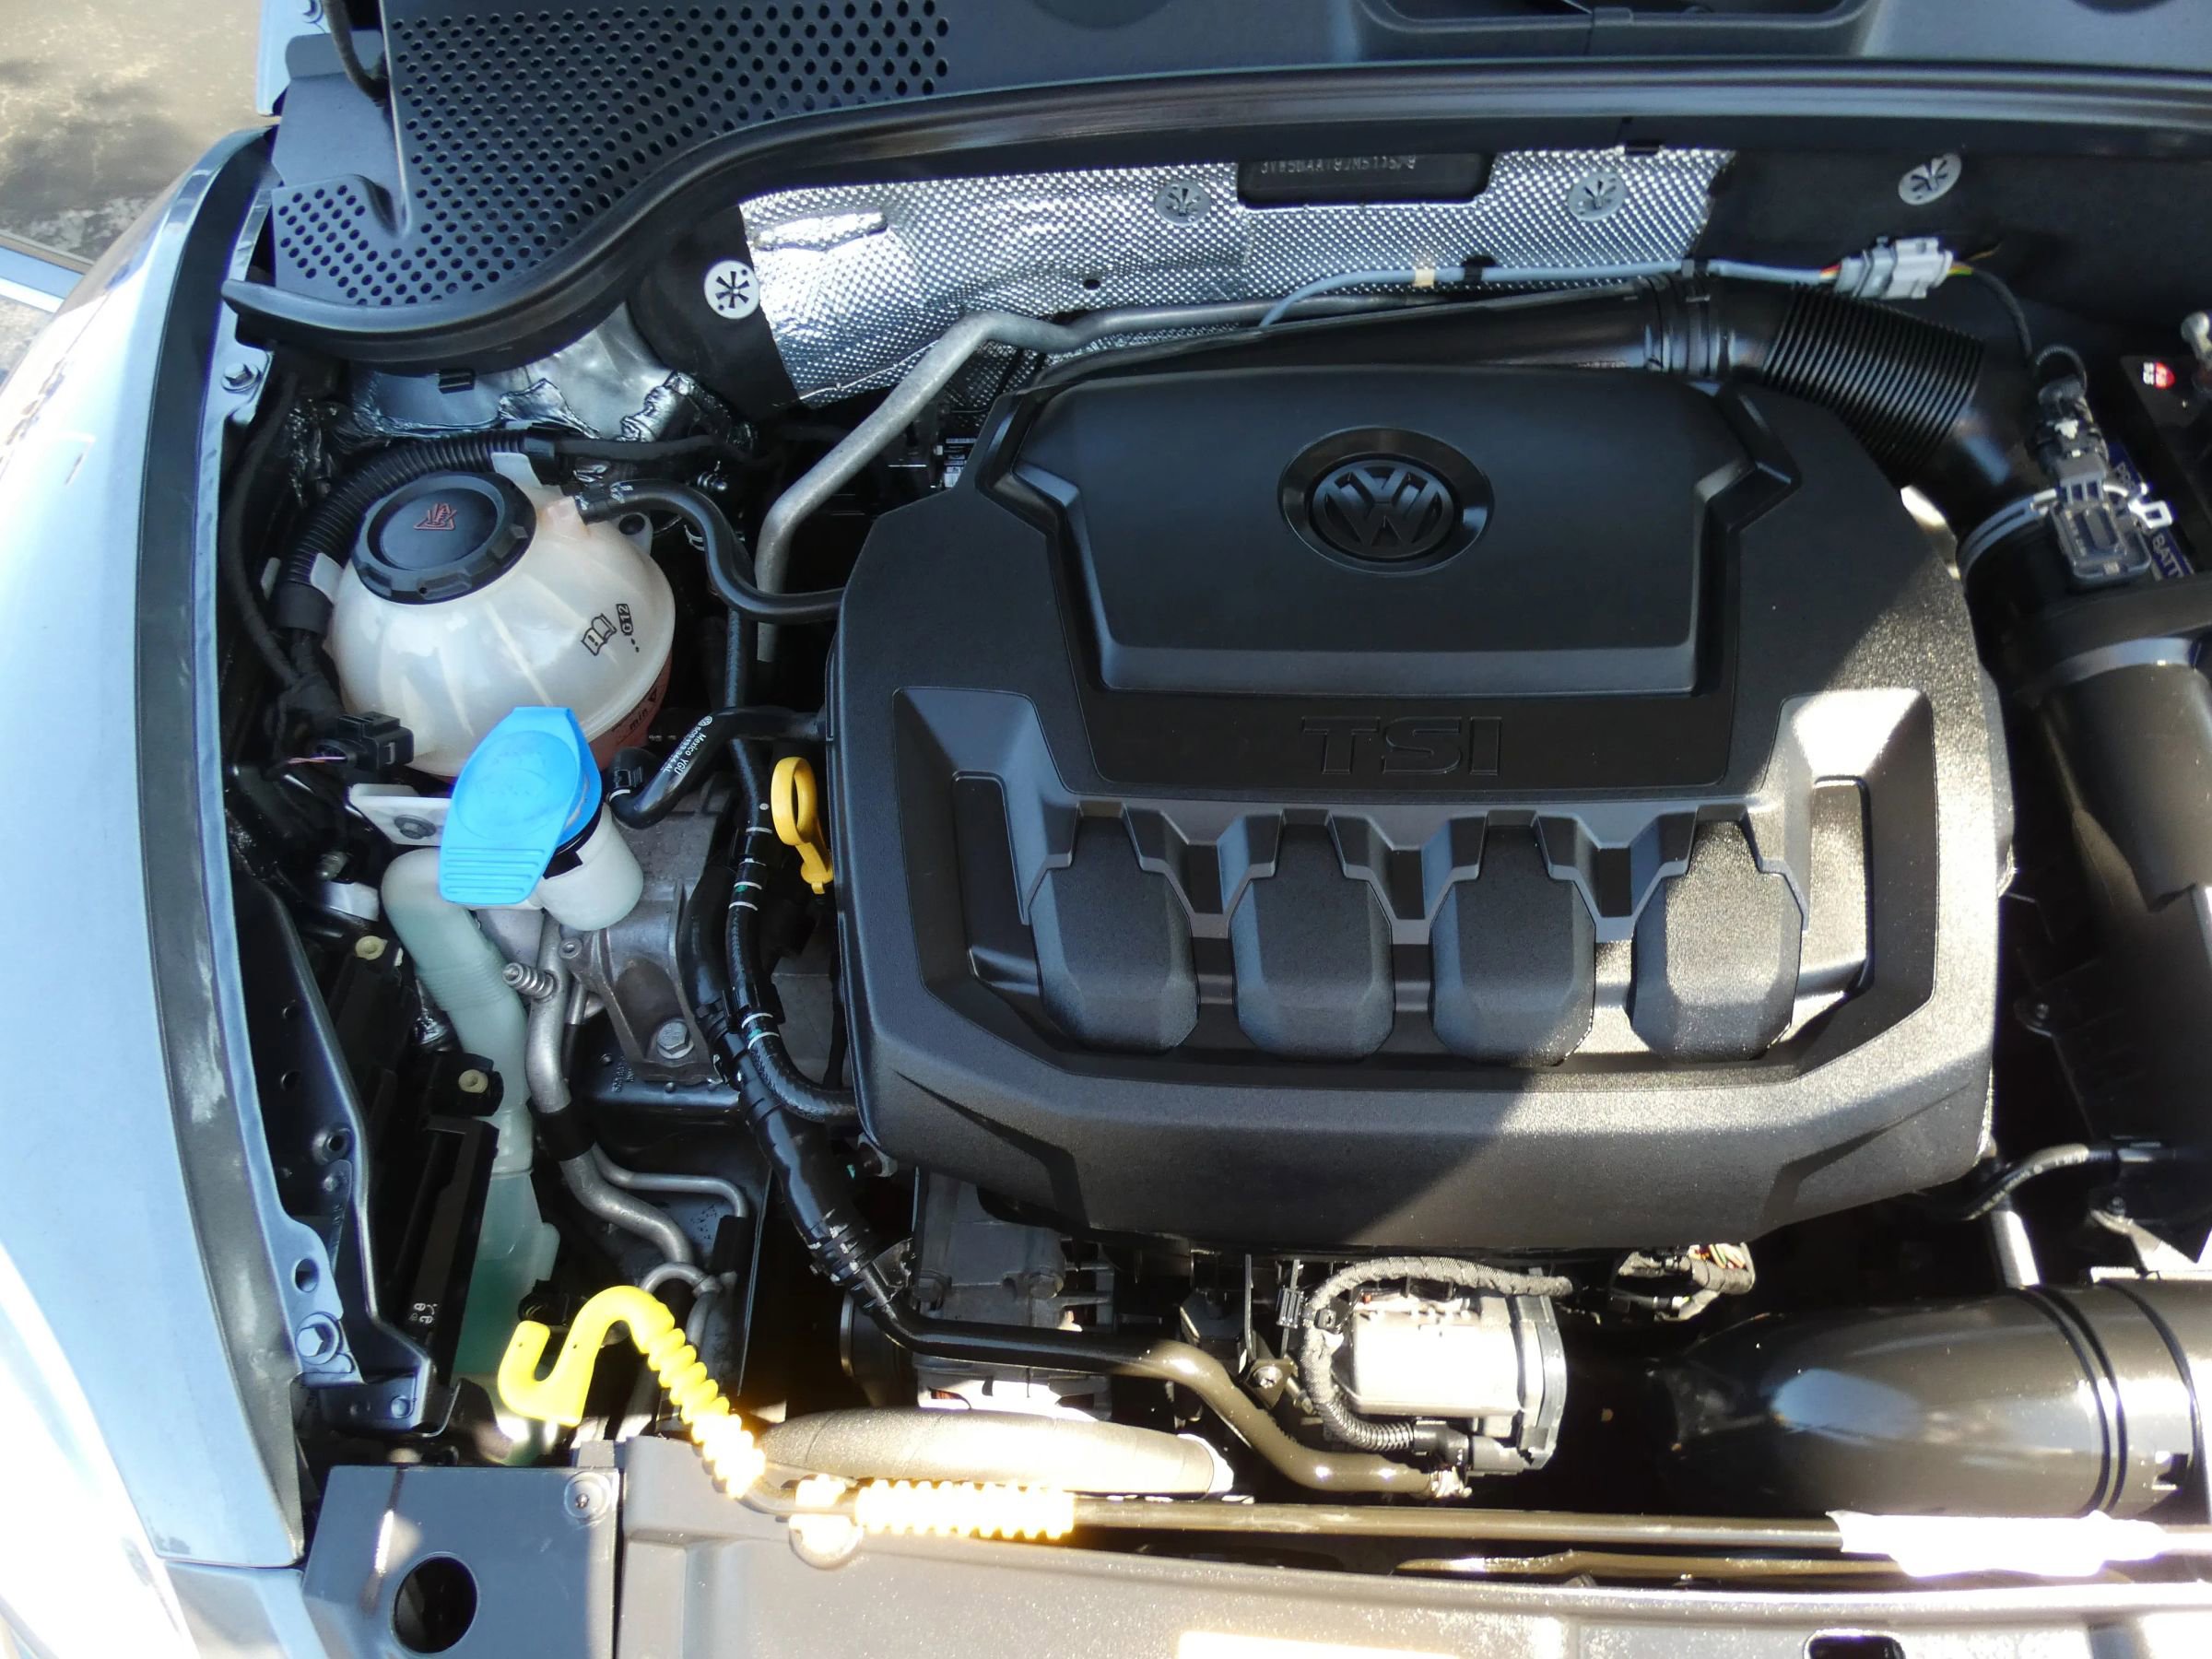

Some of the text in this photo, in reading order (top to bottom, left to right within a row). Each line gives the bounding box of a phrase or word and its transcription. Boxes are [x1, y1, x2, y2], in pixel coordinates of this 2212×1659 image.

[1312, 459, 1454, 559] VW
[618, 605, 633, 634] G12
[685, 732, 707, 756] Mexico
[1300, 716, 1502, 775] TSI
[674, 758, 689, 775] YGU
